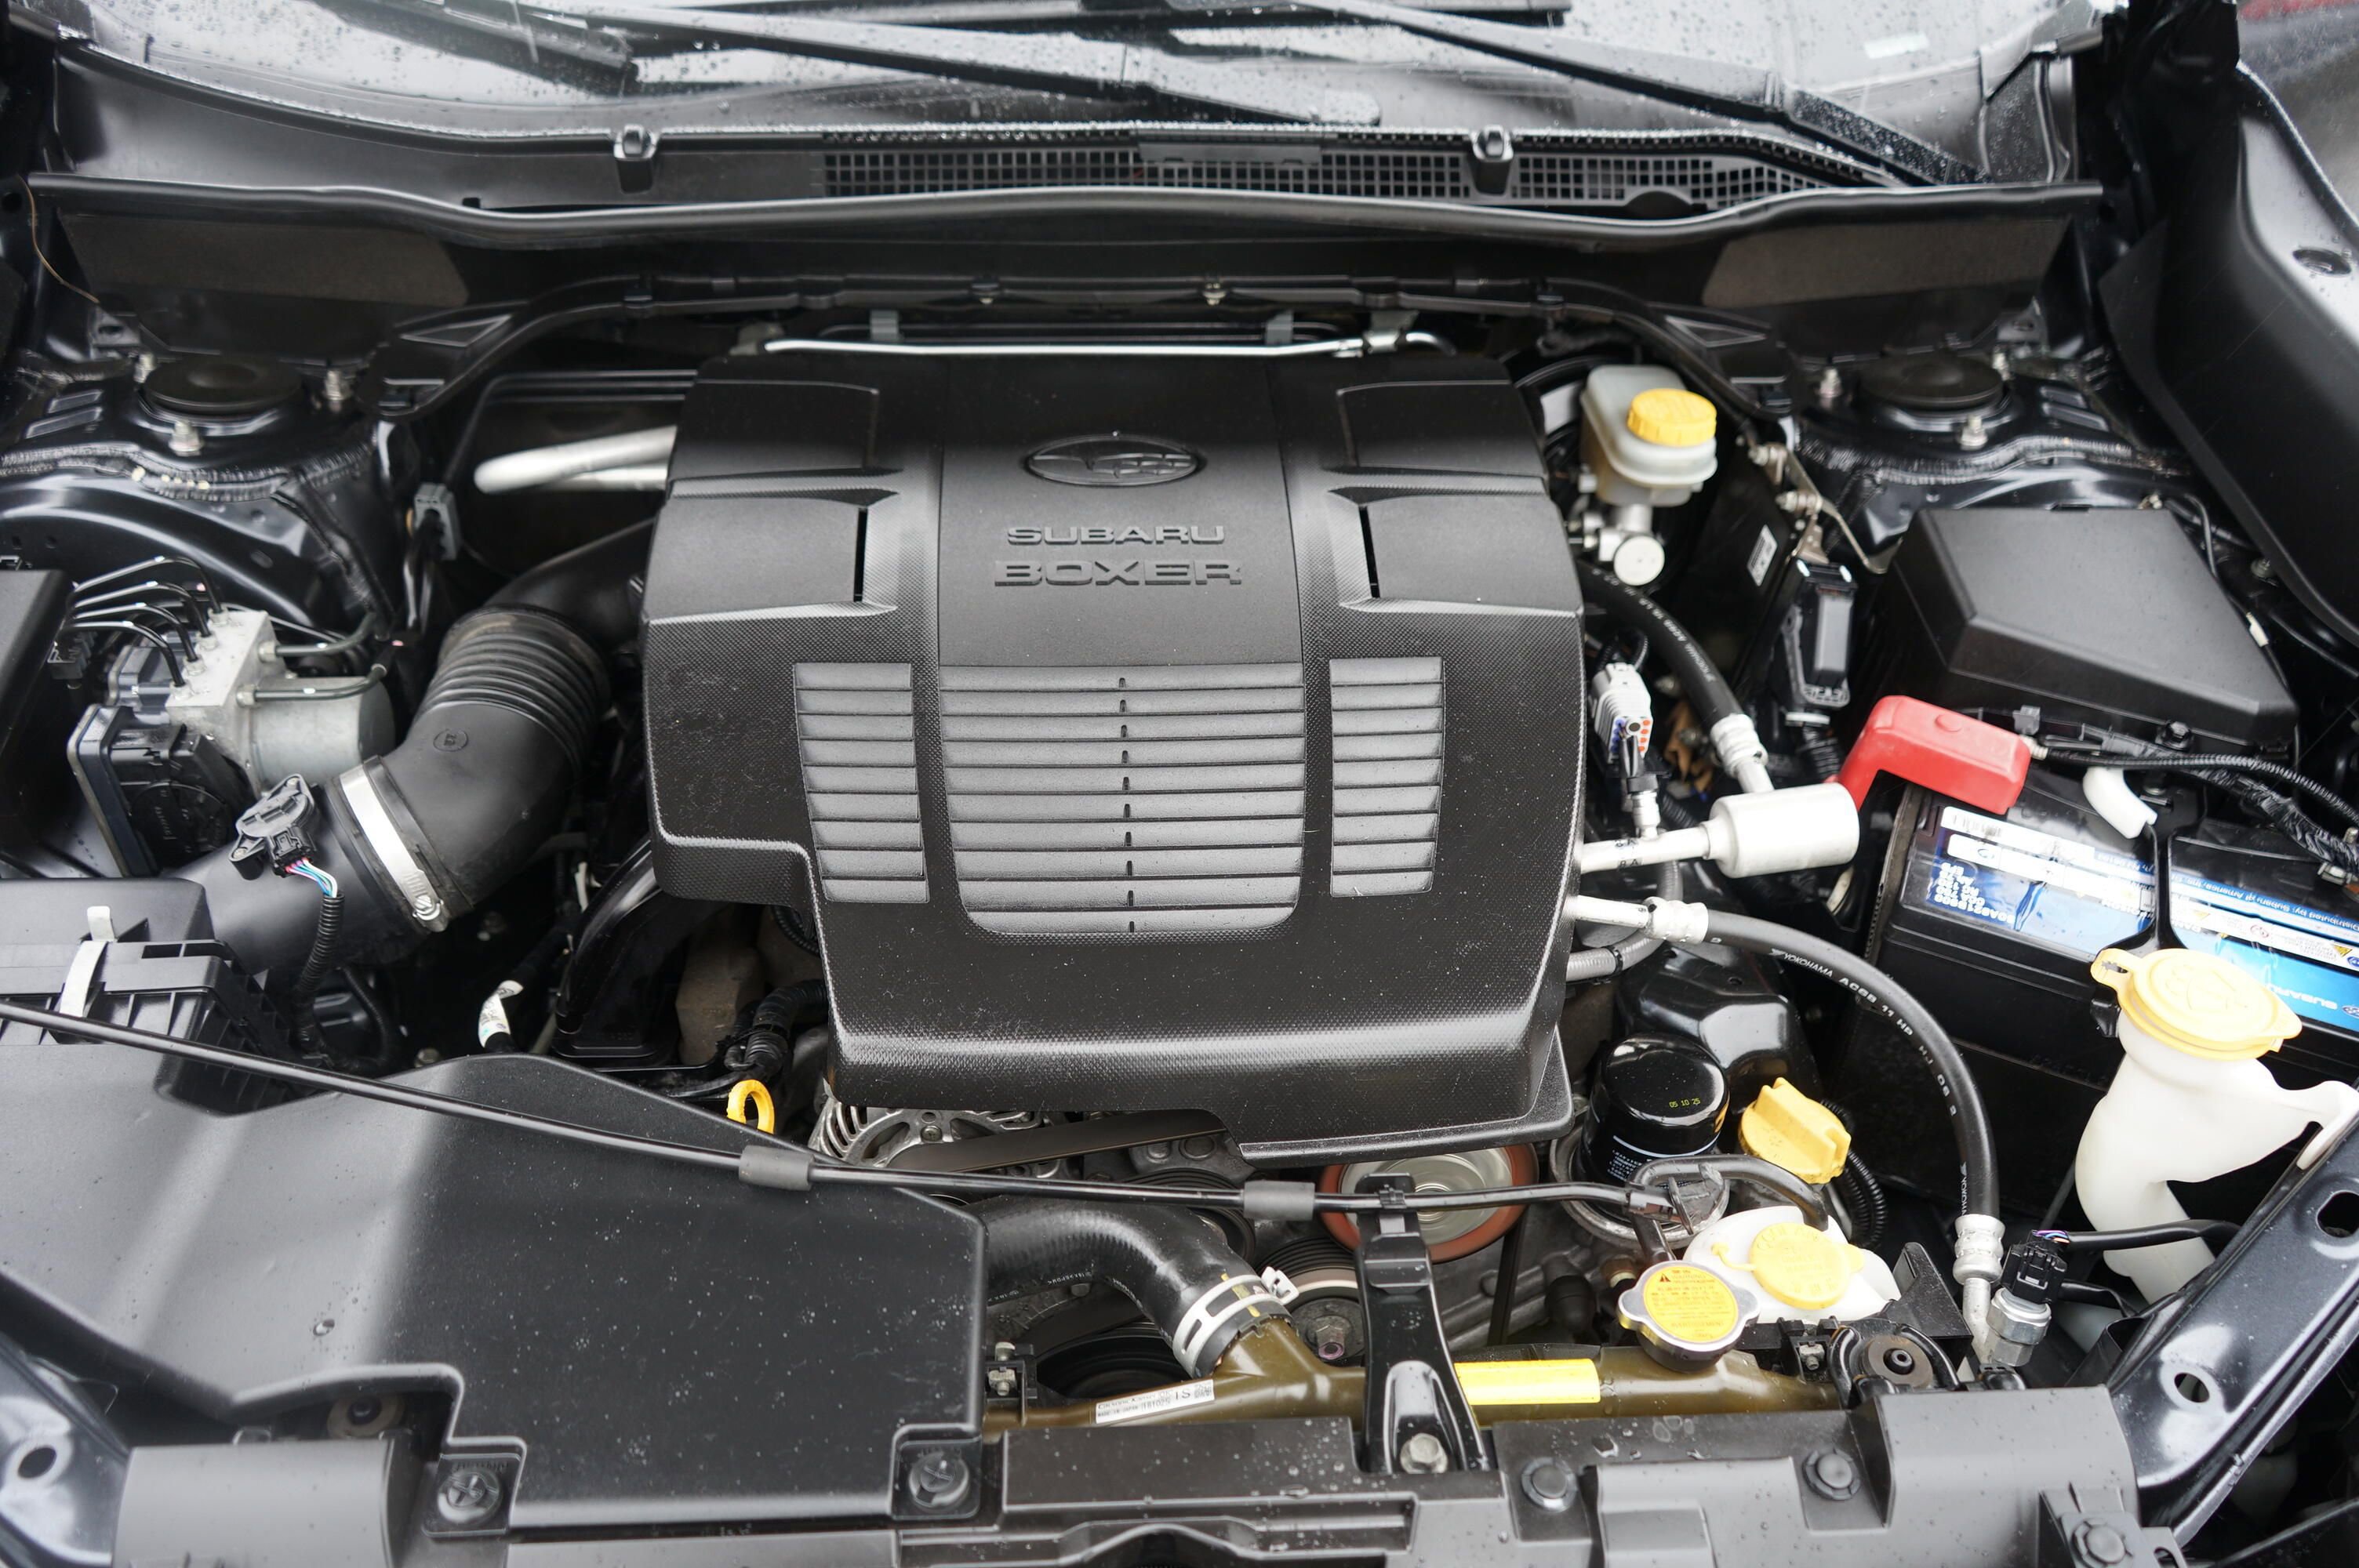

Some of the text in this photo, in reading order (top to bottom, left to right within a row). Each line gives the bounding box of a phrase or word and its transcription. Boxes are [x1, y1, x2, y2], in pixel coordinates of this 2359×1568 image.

[1008, 525, 1224, 546] SUBARU
[994, 560, 1241, 586] BOXER
[1784, 953, 1833, 978] YOKOHAMA
[1881, 1004, 1895, 1018] 11
